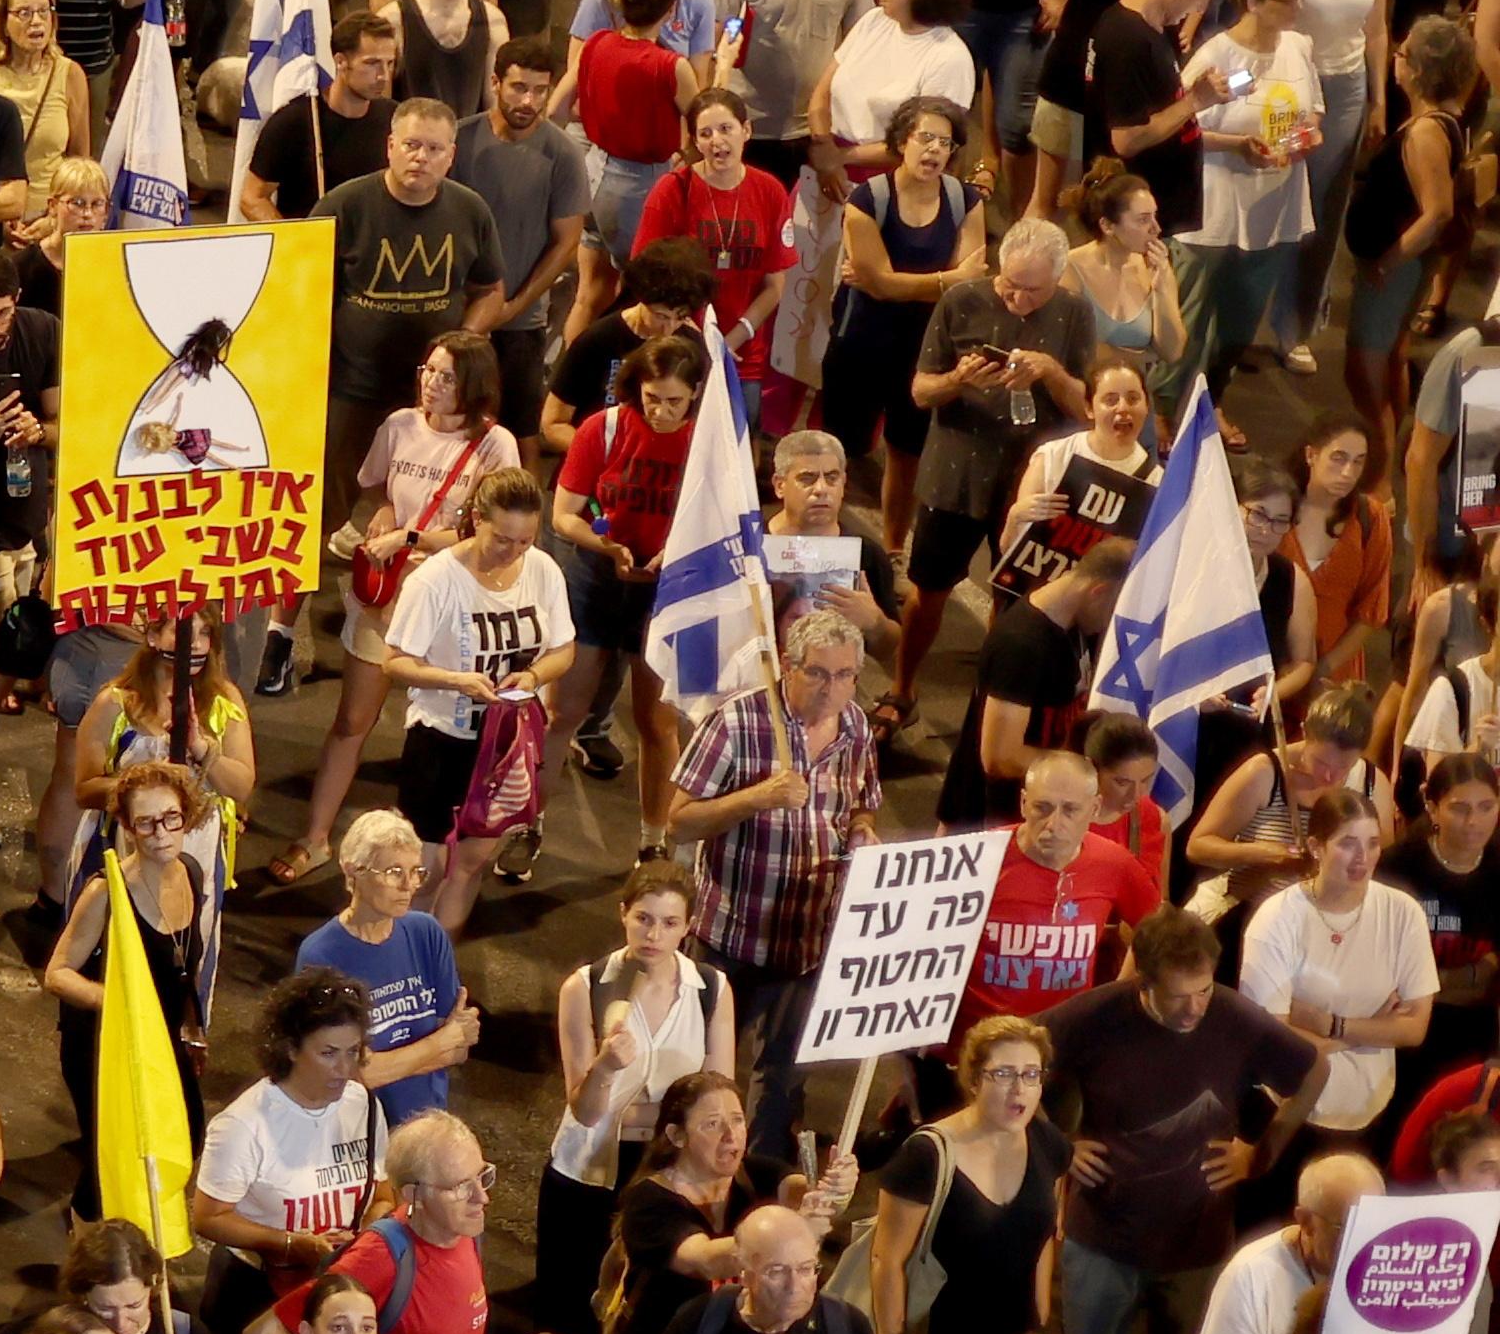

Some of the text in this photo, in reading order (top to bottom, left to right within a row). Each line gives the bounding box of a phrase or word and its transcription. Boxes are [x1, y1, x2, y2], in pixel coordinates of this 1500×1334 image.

[70, 467, 315, 531] אין לבנות
[74, 516, 309, 578] בשבי עוד
[53, 568, 303, 636] זמן לחכות
[872, 840, 984, 889] אנחנו
[848, 890, 984, 939] פה עד
[984, 920, 1097, 959] חופשי
[839, 943, 964, 996] החטוף
[983, 954, 1090, 992] בארצנו
[812, 991, 956, 1048] האחרון
[1367, 1259, 1467, 1276] وحده السلام
[1370, 1241, 1471, 1263] רק שלום
[1360, 1276, 1465, 1295] יביא ביטחון
